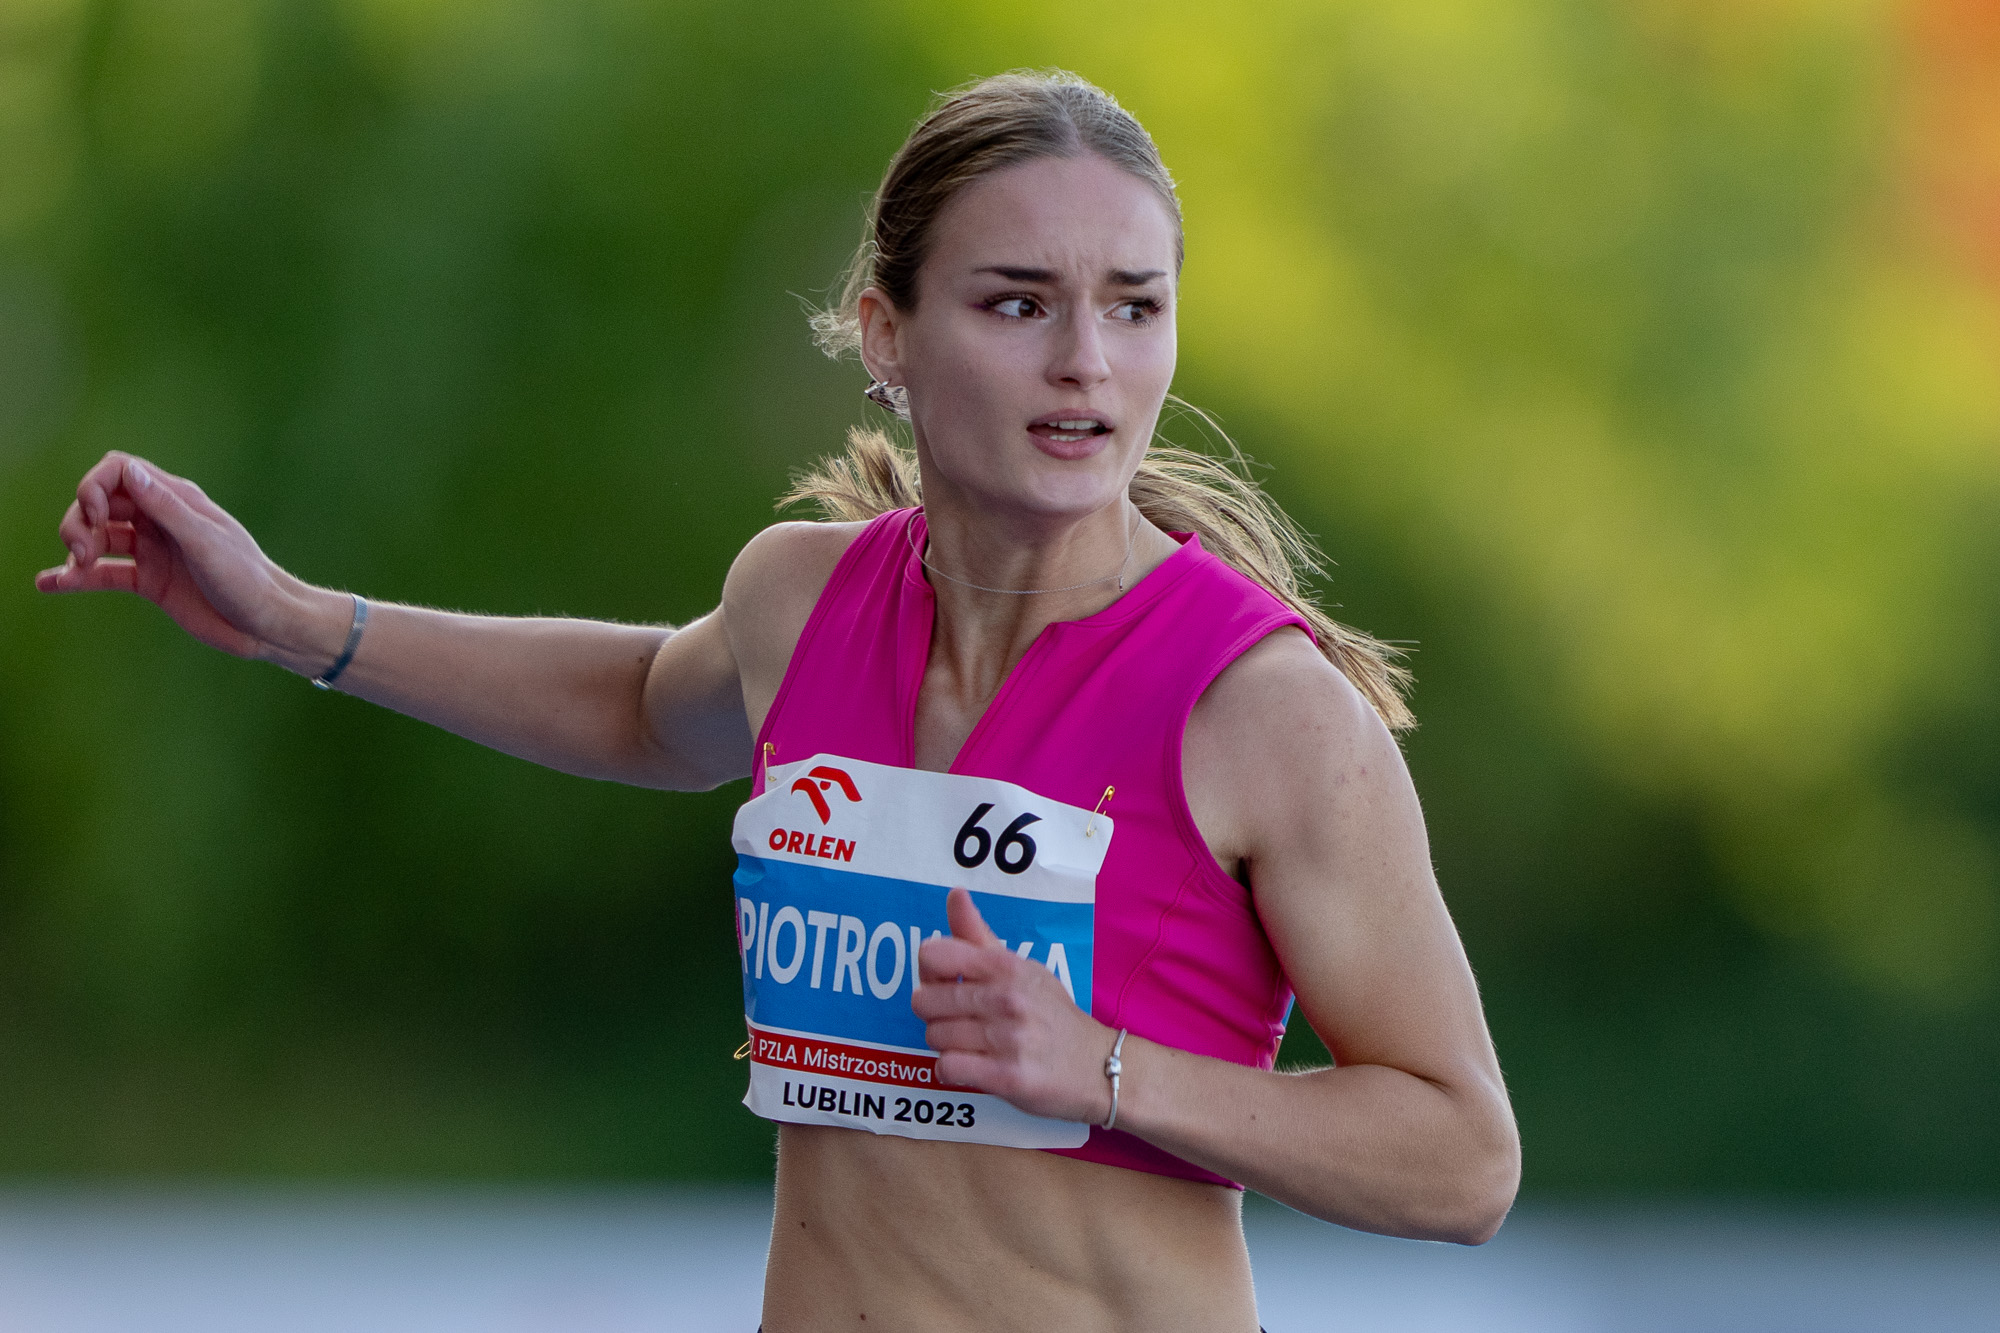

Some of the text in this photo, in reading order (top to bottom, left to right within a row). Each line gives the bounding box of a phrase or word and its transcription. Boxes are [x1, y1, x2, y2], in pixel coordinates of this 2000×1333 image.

[768, 828, 856, 863] ORLEN
[953, 803, 1042, 875] 66
[759, 1038, 797, 1064] PZLA
[803, 1047, 932, 1084] Mistrzostwa
[783, 1081, 976, 1128] LUBLIN 2023
